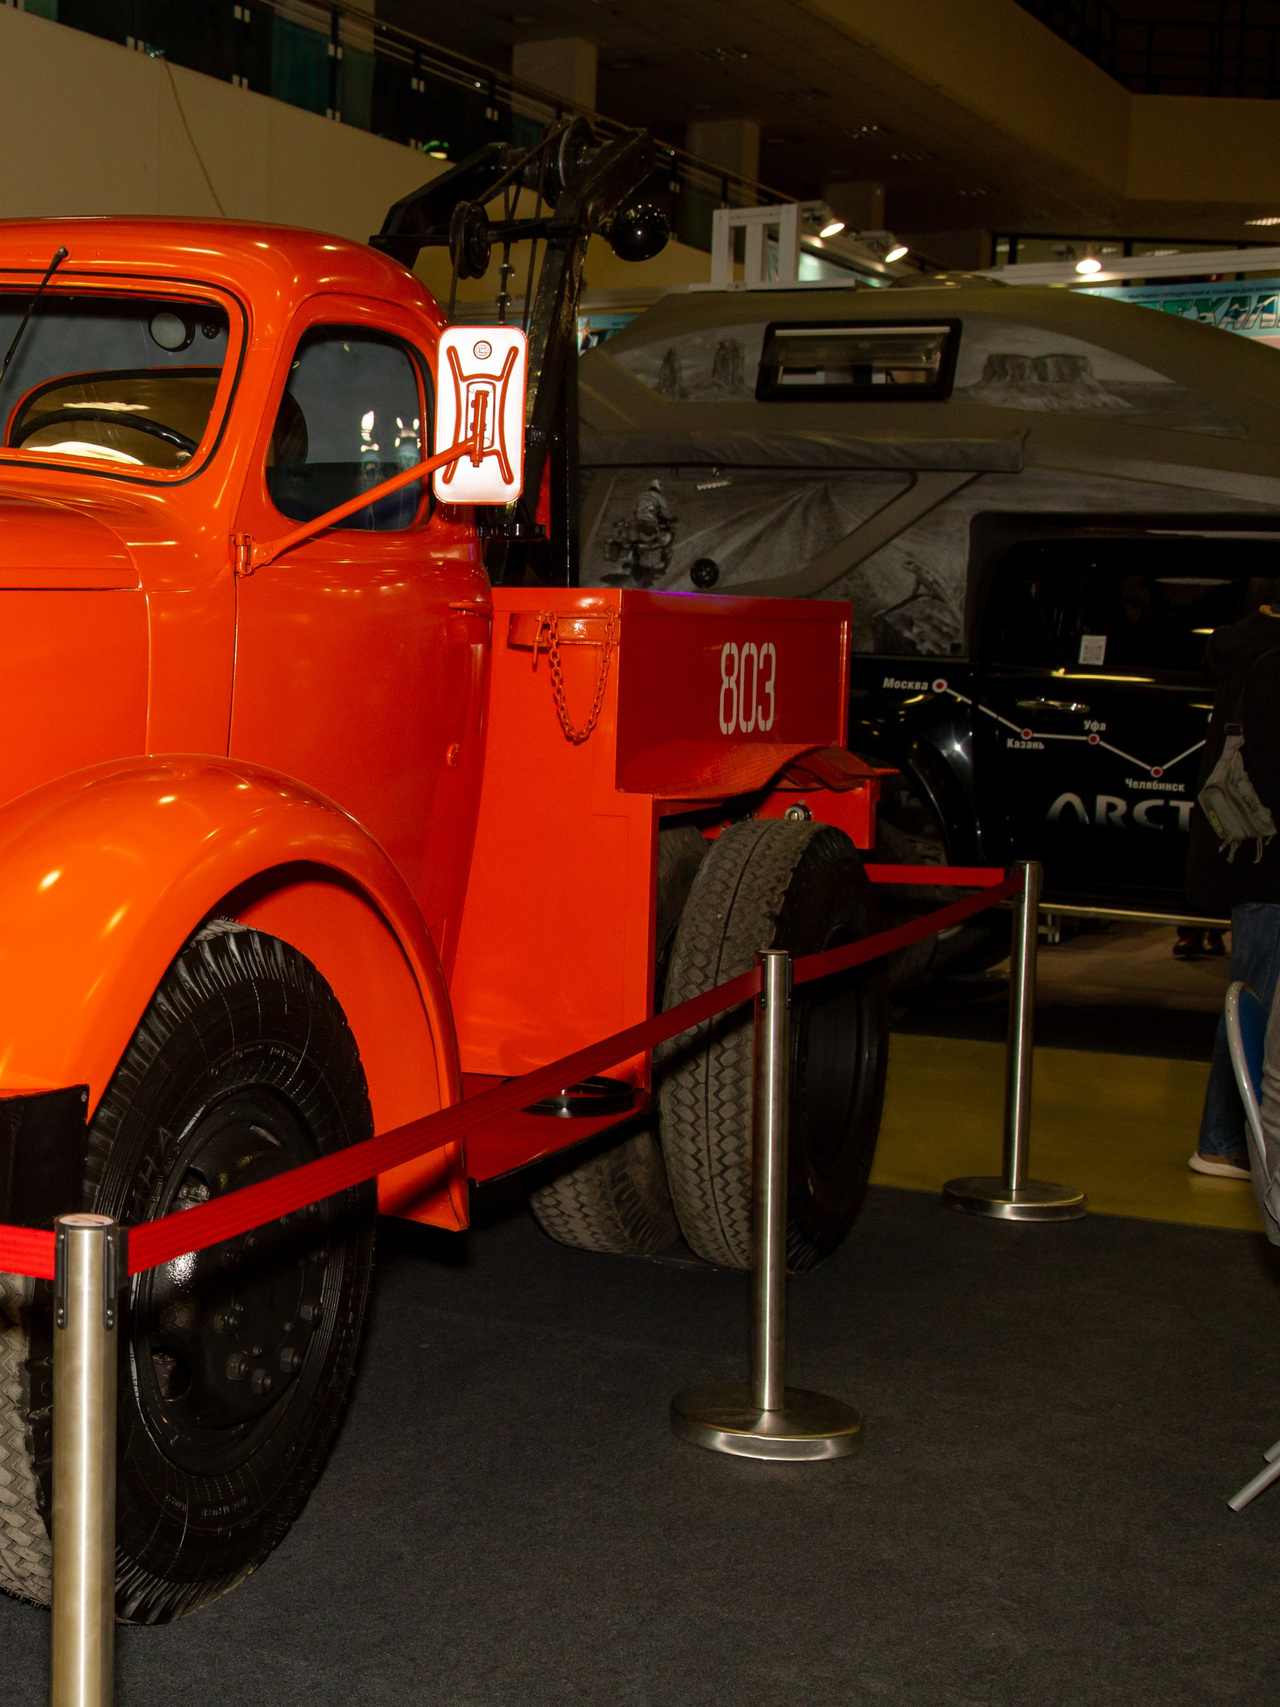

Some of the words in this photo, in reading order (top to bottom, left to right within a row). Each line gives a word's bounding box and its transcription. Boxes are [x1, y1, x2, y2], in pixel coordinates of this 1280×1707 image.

[720, 641, 777, 735] 803
[882, 676, 930, 691] Москва
[1083, 718, 1107, 733] Уфа
[1006, 737, 1045, 751] Казань
[1124, 777, 1186, 793] Челябинск
[1044, 791, 1195, 833] ARCT
